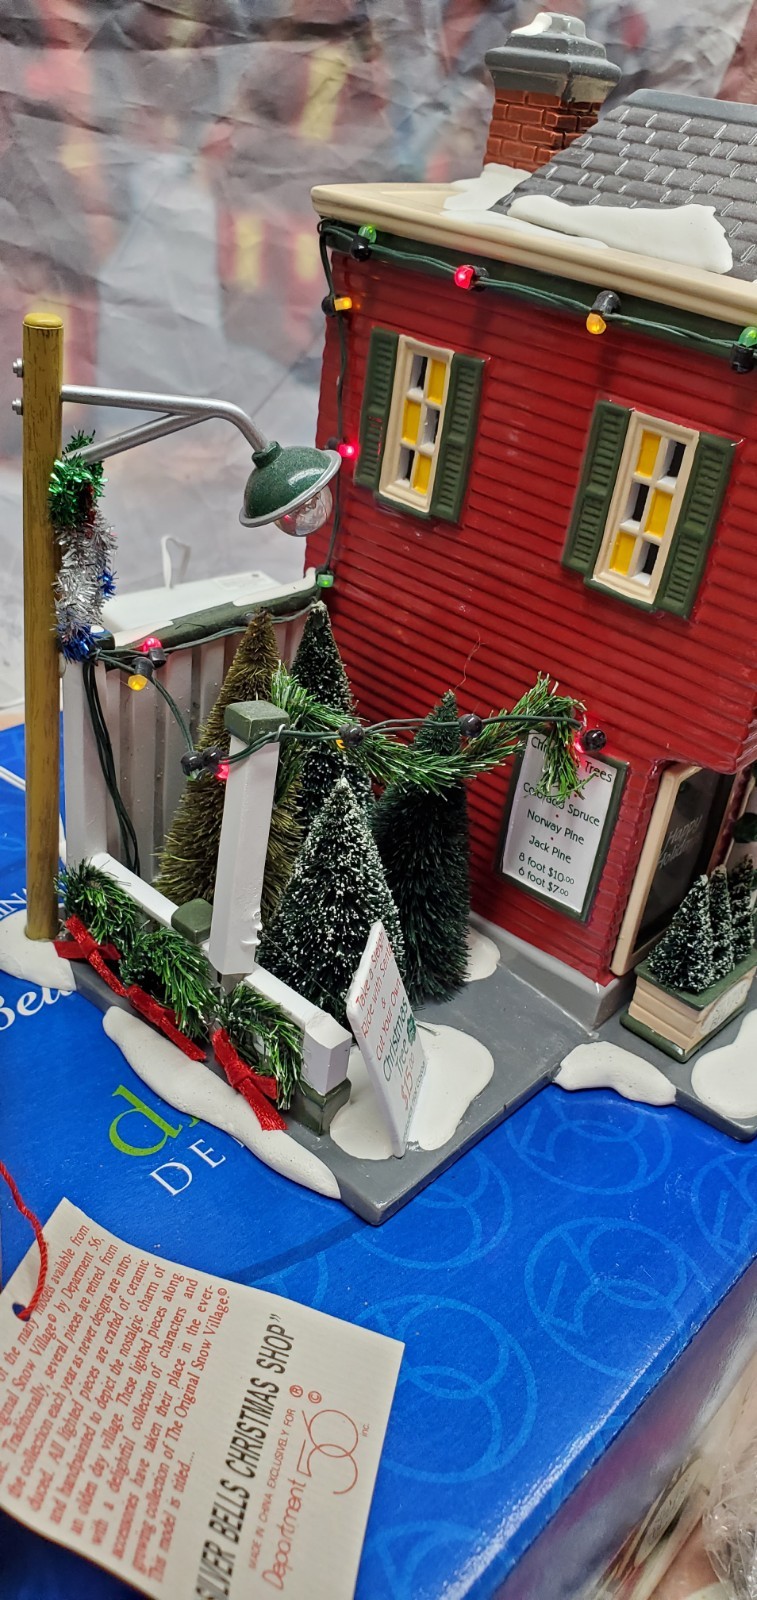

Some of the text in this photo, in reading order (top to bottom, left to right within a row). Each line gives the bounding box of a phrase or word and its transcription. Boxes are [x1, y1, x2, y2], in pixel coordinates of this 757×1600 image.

[527, 809, 585, 846] Norway Pine
[567, 804, 601, 827] Spruce
[518, 852, 525, 862] 8
[527, 856, 546, 874] foot
[529, 835, 572, 864] Jack Pine
[518, 866, 525, 876] 6
[527, 871, 546, 888] foot
[356, 979, 370, 1011] Take
[361, 1004, 375, 1039] Ride
[372, 976, 382, 1004] with
[376, 1034, 386, 1061] Cut
[382, 1006, 393, 1037] Your
[383, 996, 409, 1082] Christmas
[395, 1038, 409, 1078] Tree
[61, 1251, 94, 1299] Department
[112, 1254, 132, 1277] intro-
[154, 1264, 166, 1279] of
[18, 1318, 39, 1345] many
[51, 1248, 75, 1284] available
[70, 1225, 90, 1247] from
[108, 1277, 121, 1294] are
[137, 1282, 159, 1312] charm
[197, 1285, 213, 1313] ever-
[45, 1339, 68, 1379] several
[64, 1312, 83, 1344] pieces
[79, 1296, 91, 1312] are
[86, 1265, 106, 1297] retired
[99, 1244, 118, 1266] from
[54, 1299, 71, 1312] by
[90, 1293, 113, 1327] designs
[79, 1325, 97, 1356] newer
[116, 1376, 138, 1407] These
[129, 1338, 153, 1375] lighted
[147, 1306, 168, 1340] pieces
[162, 1273, 185, 1302] along
[120, 1314, 143, 1357] nostalgic
[185, 1318, 201, 1336] the
[57, 1398, 84, 1442] lighted
[79, 1365, 100, 1402] pieces
[96, 1346, 109, 1364] are
[104, 1310, 124, 1345] crafted
[119, 1295, 131, 1311] of
[127, 1259, 149, 1296] ceramic
[73, 1354, 84, 1369] as
[132, 1380, 157, 1431] collection
[151, 1361, 163, 1379] of
[158, 1307, 187, 1359] characters
[184, 1278, 198, 1299] and
[178, 1341, 193, 1353] in
[191, 1339, 212, 1371] Snow
[12, 1359, 36, 1392] Snow
[61, 1366, 77, 1395] year
[109, 1359, 124, 1376] the
[167, 1358, 186, 1389] place
[48, 1391, 66, 1418] each
[95, 1376, 117, 1410] depict
[155, 1390, 173, 1417] their
[174, 1372, 200, 1418] Original
[90, 1411, 102, 1424] to
[165, 1420, 183, 1441] The
[225, 1377, 280, 1479] CHRISTMAS
[144, 1422, 163, 1453] taken
[163, 1441, 175, 1460] of
[259, 1492, 273, 1523] CHINA
[267, 1429, 290, 1489] EXCLUSIVELY
[283, 1408, 296, 1427] FOR
[209, 1478, 250, 1544] BELLS
[261, 1478, 306, 1590] Department
